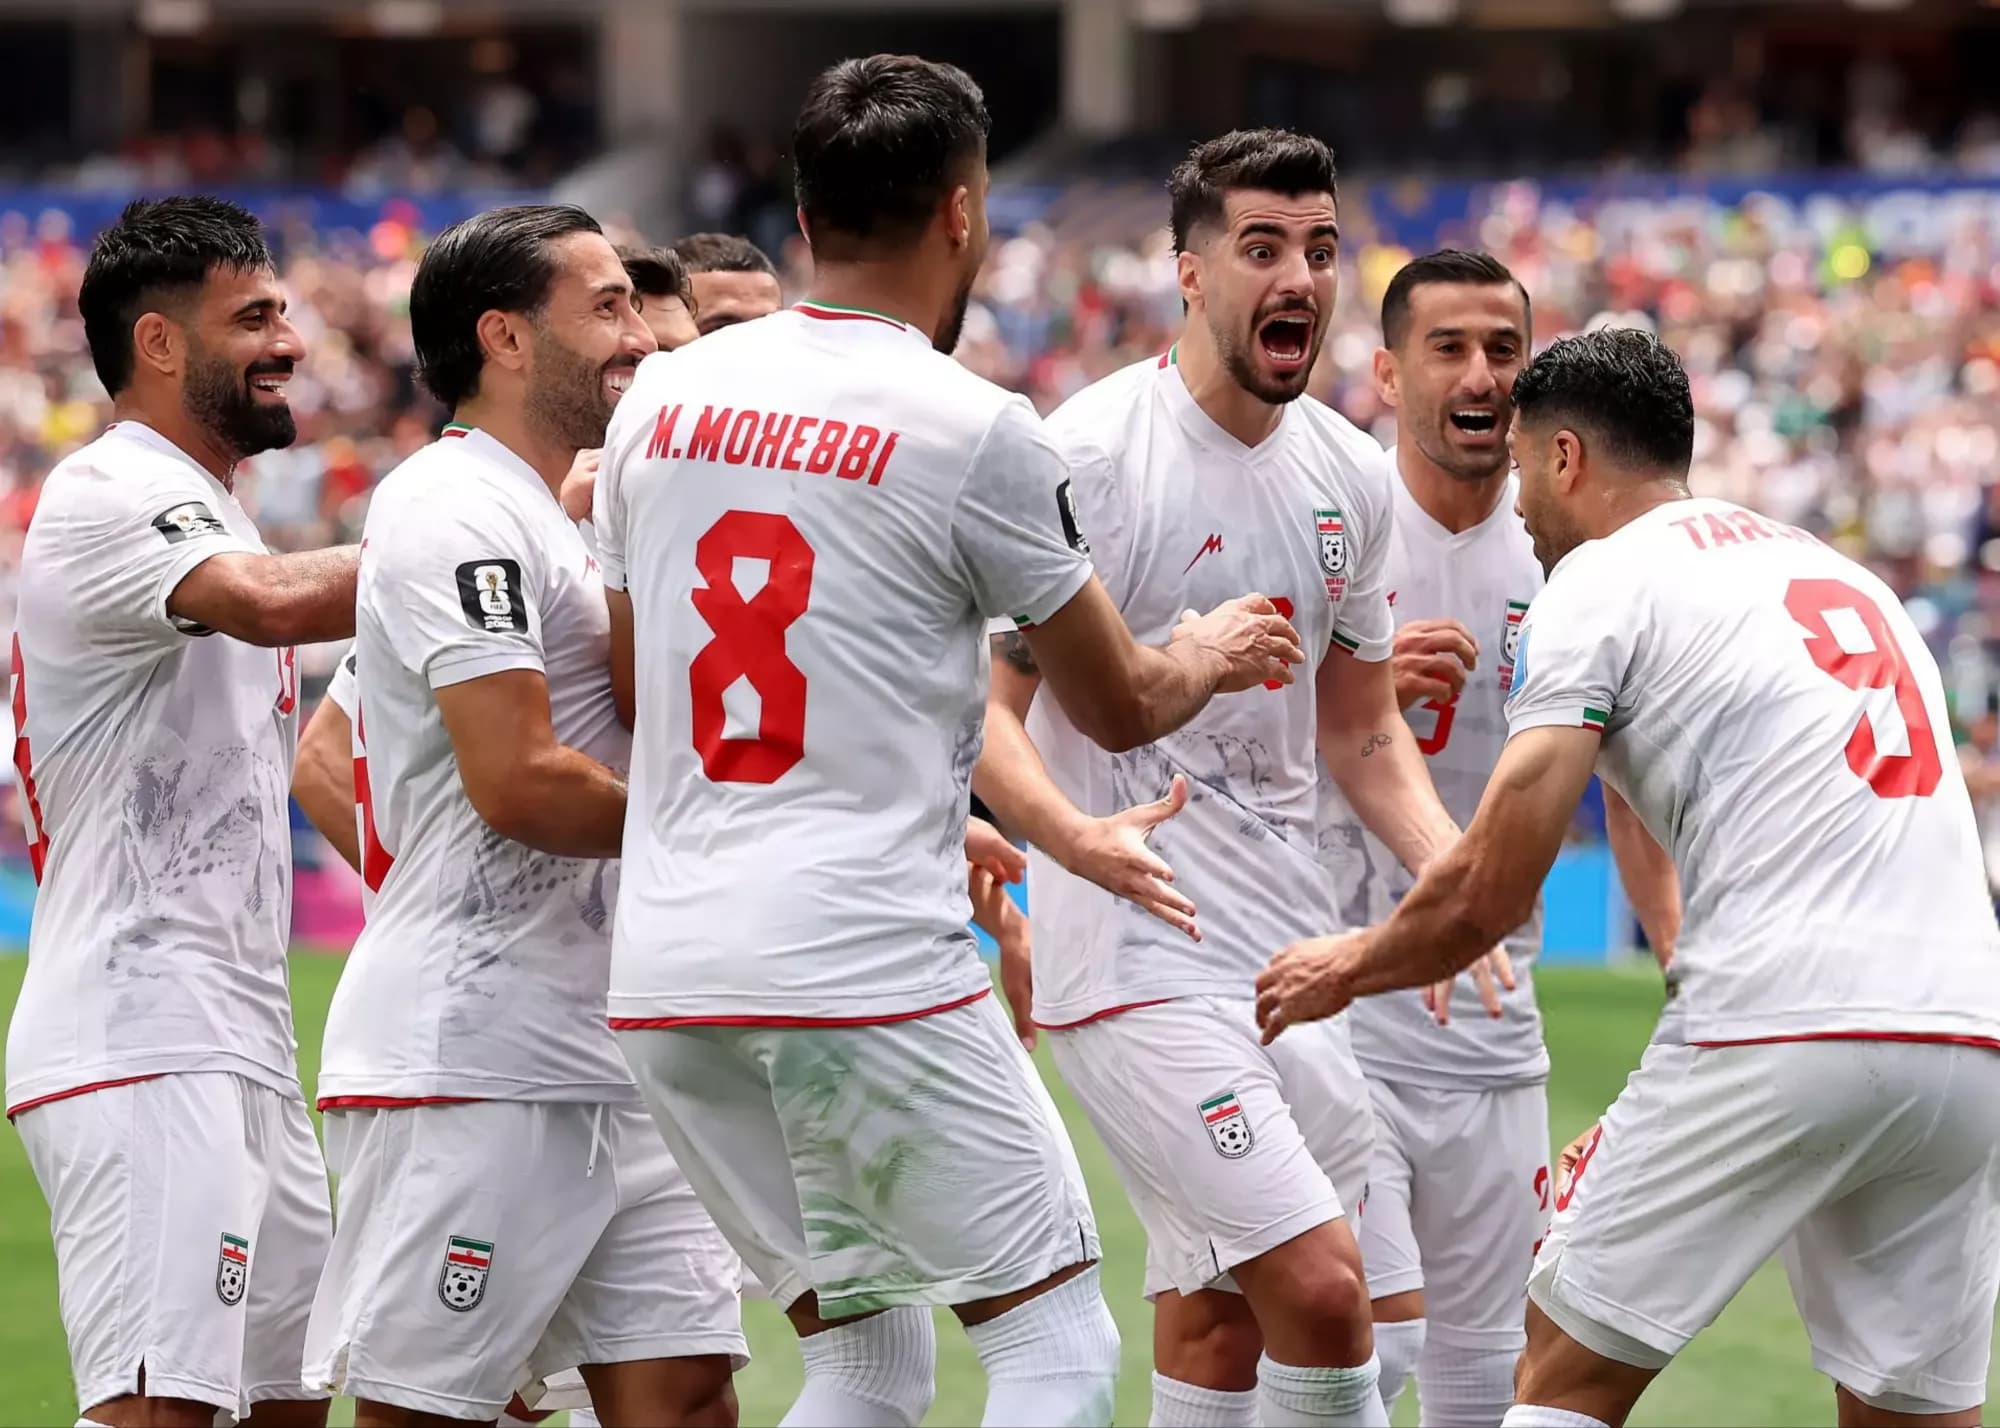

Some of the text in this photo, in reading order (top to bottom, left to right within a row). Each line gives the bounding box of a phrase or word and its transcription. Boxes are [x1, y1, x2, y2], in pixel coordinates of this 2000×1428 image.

[646, 404, 900, 486] M.MOHEBBI
[689, 509, 815, 784] 8
[1783, 578, 1944, 798] 9
